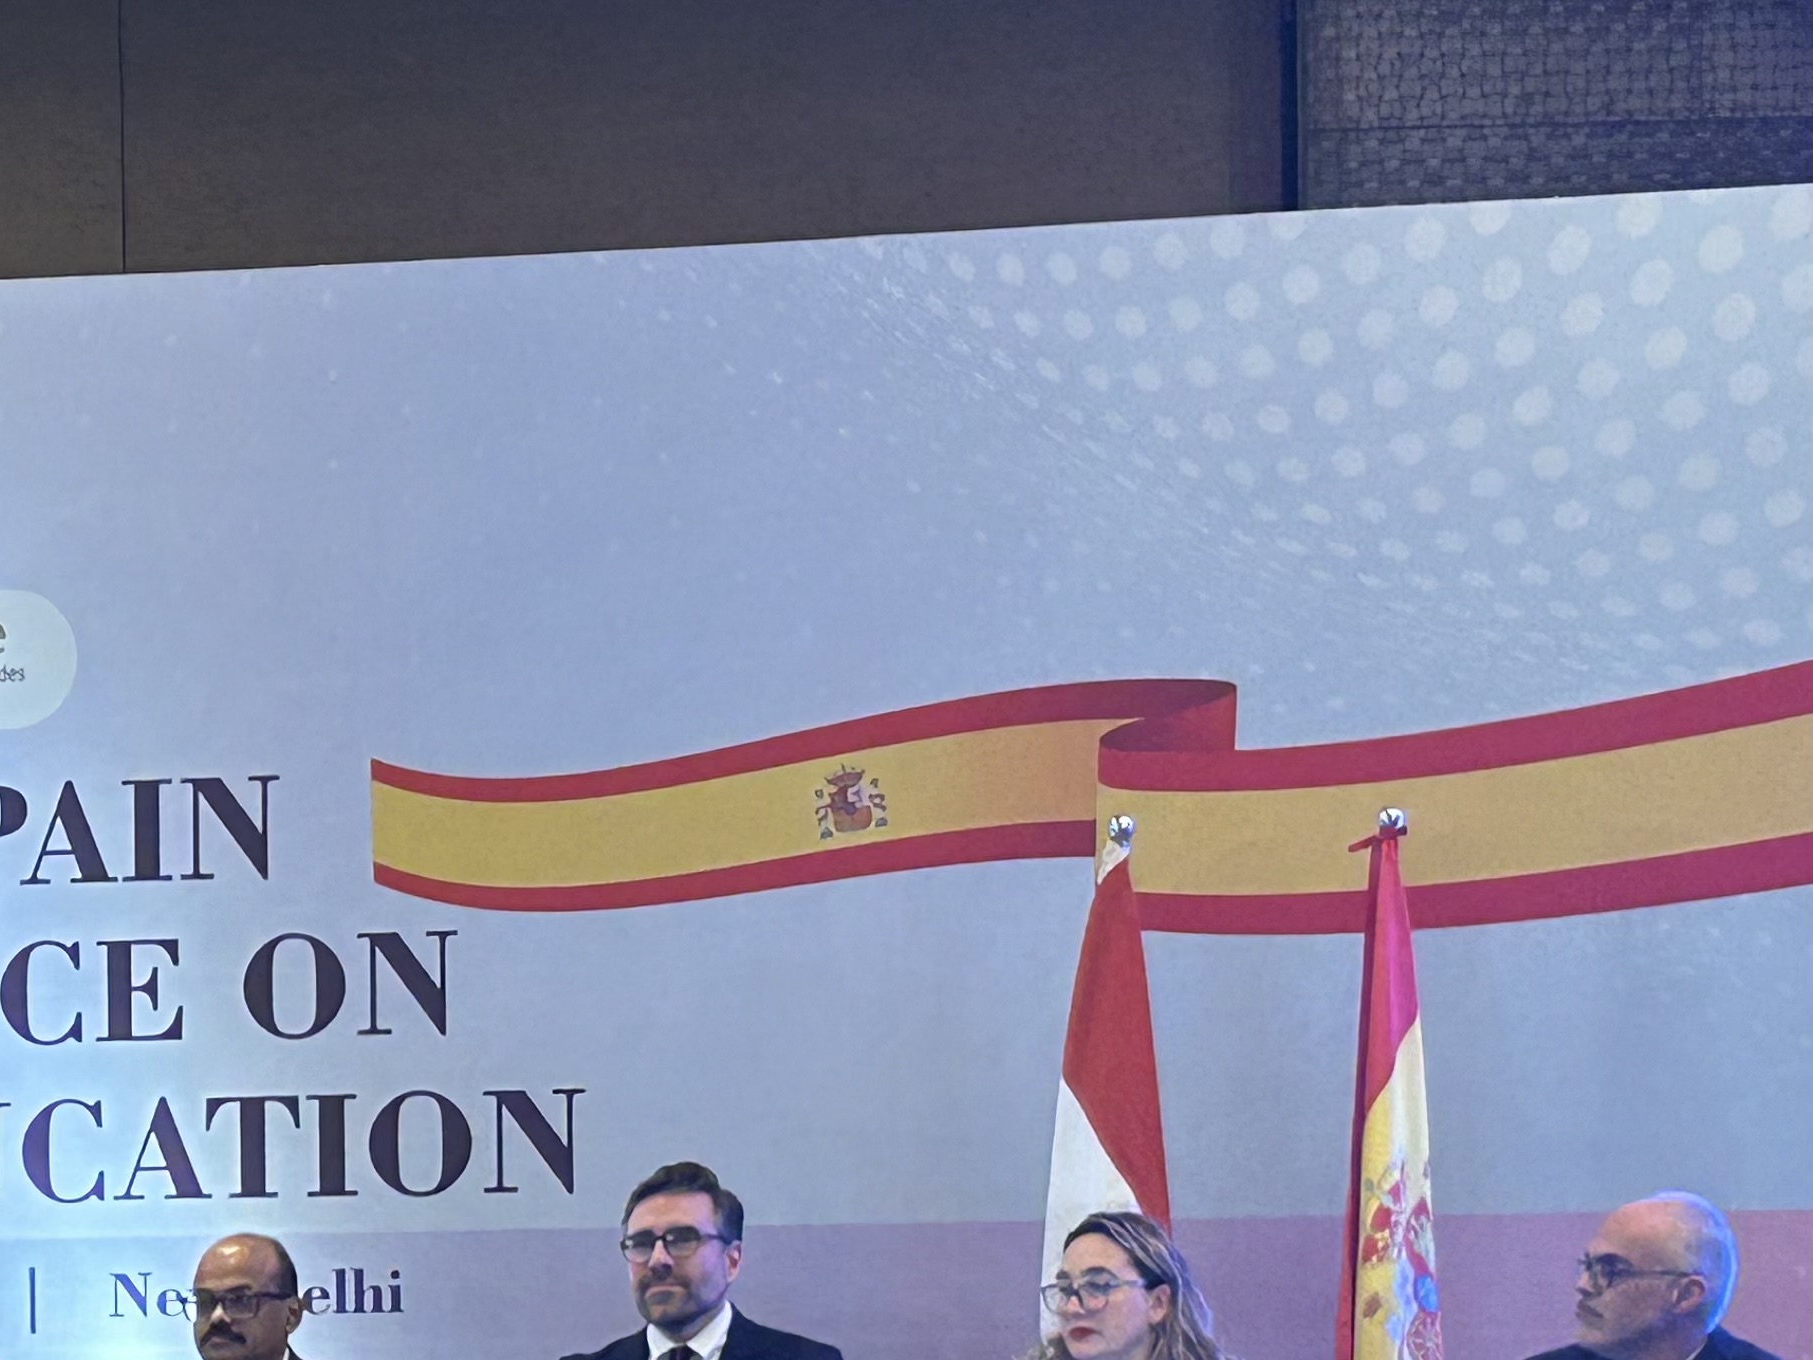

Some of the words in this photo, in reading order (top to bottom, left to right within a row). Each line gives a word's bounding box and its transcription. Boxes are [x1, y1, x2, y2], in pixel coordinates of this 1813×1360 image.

[243, 930, 458, 1040] ON
[109, 1272, 194, 1321] Ne
[302, 1266, 405, 1316] elhi
